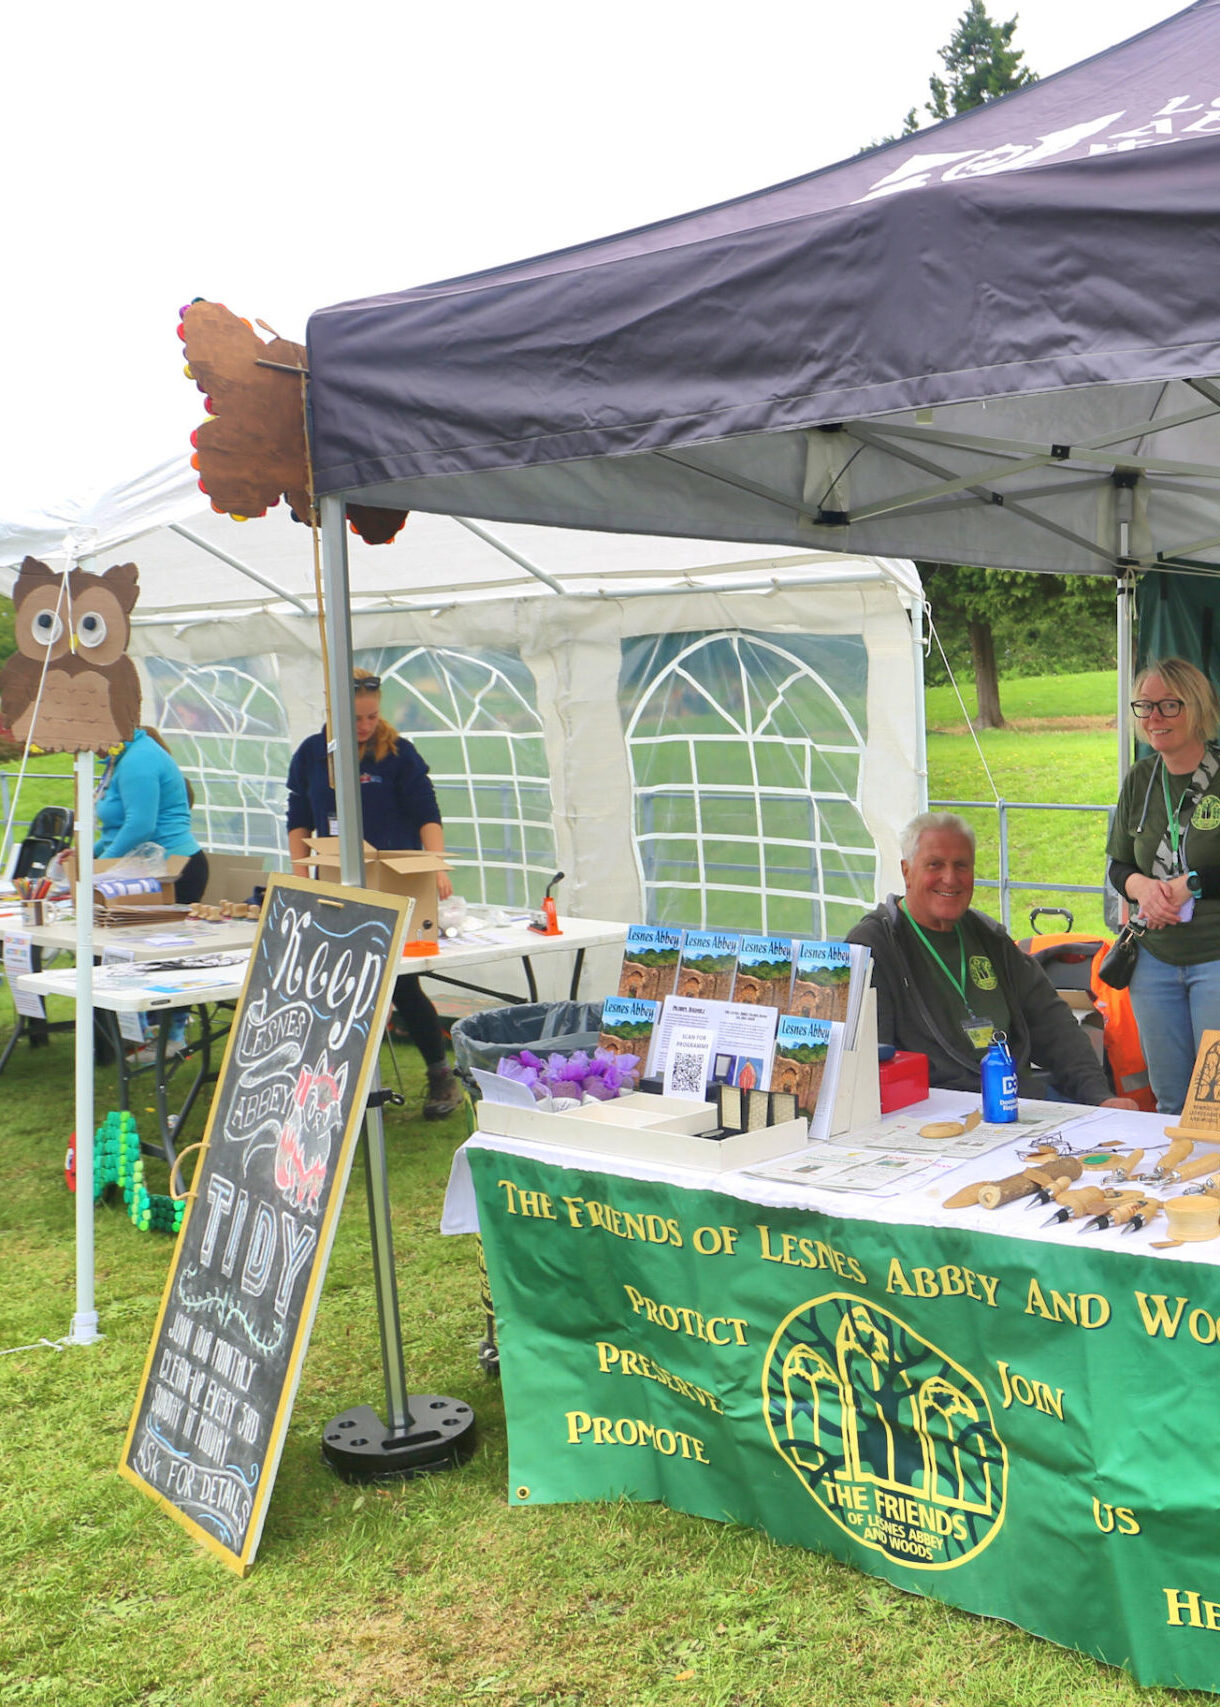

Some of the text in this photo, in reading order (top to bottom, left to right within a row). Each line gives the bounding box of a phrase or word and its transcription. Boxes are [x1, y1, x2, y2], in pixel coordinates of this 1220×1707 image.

[628, 926, 680, 947] Lesnes Abbey
[685, 932, 738, 953] Lesnes Abbey
[741, 938, 792, 959] Lesnes Abbey
[800, 944, 850, 964] Lesnes Abbey
[271, 906, 382, 1050] Keep
[241, 1009, 307, 1058] LESNES
[604, 1000, 629, 1014] Lesnes
[630, 1002, 655, 1020] Abbey
[782, 1021, 807, 1037] Lesnes
[808, 1025, 830, 1043] Abbey
[231, 1083, 296, 1129] ABBEY
[201, 1172, 317, 1318] TIDY
[497, 1179, 558, 1222] THE
[561, 1195, 685, 1249] FRIENDS
[692, 1225, 740, 1257] OF
[755, 1224, 869, 1285] LESNES
[885, 1257, 1001, 1308] ABBEY
[1024, 1277, 1111, 1330] AND
[623, 1284, 750, 1347] PROTECT
[168, 1311, 258, 1392] JOIN OUR MONTHLY
[595, 1341, 725, 1417] PRESERVE
[203, 1379, 239, 1429] EVERY
[237, 1401, 260, 1445] 3RD
[996, 1360, 1065, 1421] JOIN
[151, 1383, 232, 1467] SUNDAY AT MIDDAY
[565, 1410, 711, 1465] PROMOTE
[166, 1460, 195, 1498] FOR
[200, 1474, 250, 1534] DETAILS
[821, 1479, 969, 1541] THE FRIENDS
[1091, 1495, 1142, 1537] US
[848, 1512, 944, 1551] OF LESNES ABBEY
[863, 1527, 934, 1561] AND WOODS
